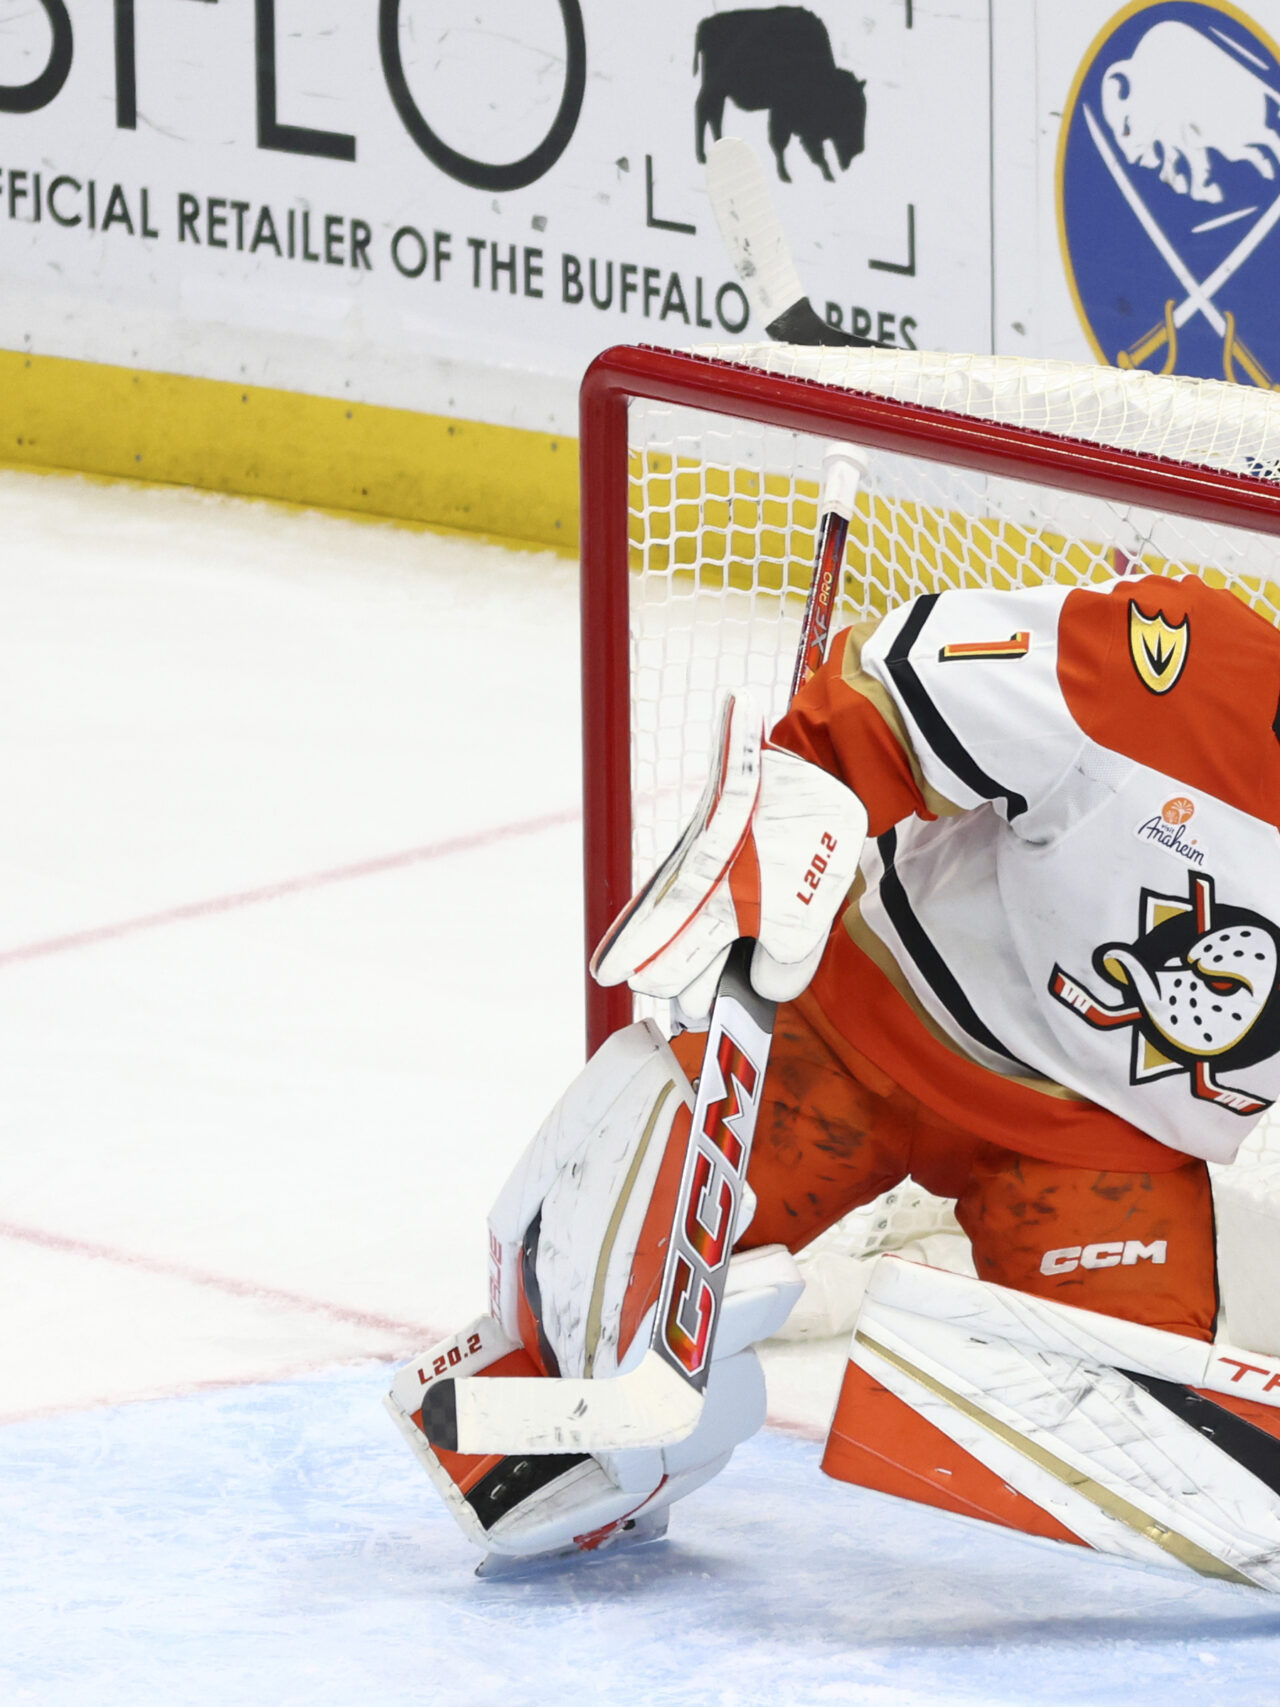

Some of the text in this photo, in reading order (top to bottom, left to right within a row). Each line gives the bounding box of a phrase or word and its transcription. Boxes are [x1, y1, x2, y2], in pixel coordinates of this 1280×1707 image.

[0, 167, 159, 239] FICIAL
[178, 192, 373, 271] RETAILER
[391, 225, 452, 282] OF
[467, 237, 543, 298] THE
[561, 252, 750, 334] BUFFALO
[819, 571, 833, 606] PRO
[938, 631, 1030, 663] 1
[1138, 815, 1204, 866] Anaheim
[796, 831, 838, 905] L20.2
[661, 1023, 761, 1378] CCM
[1040, 1240, 1167, 1276] CCM
[417, 1332, 483, 1385] L20.2
